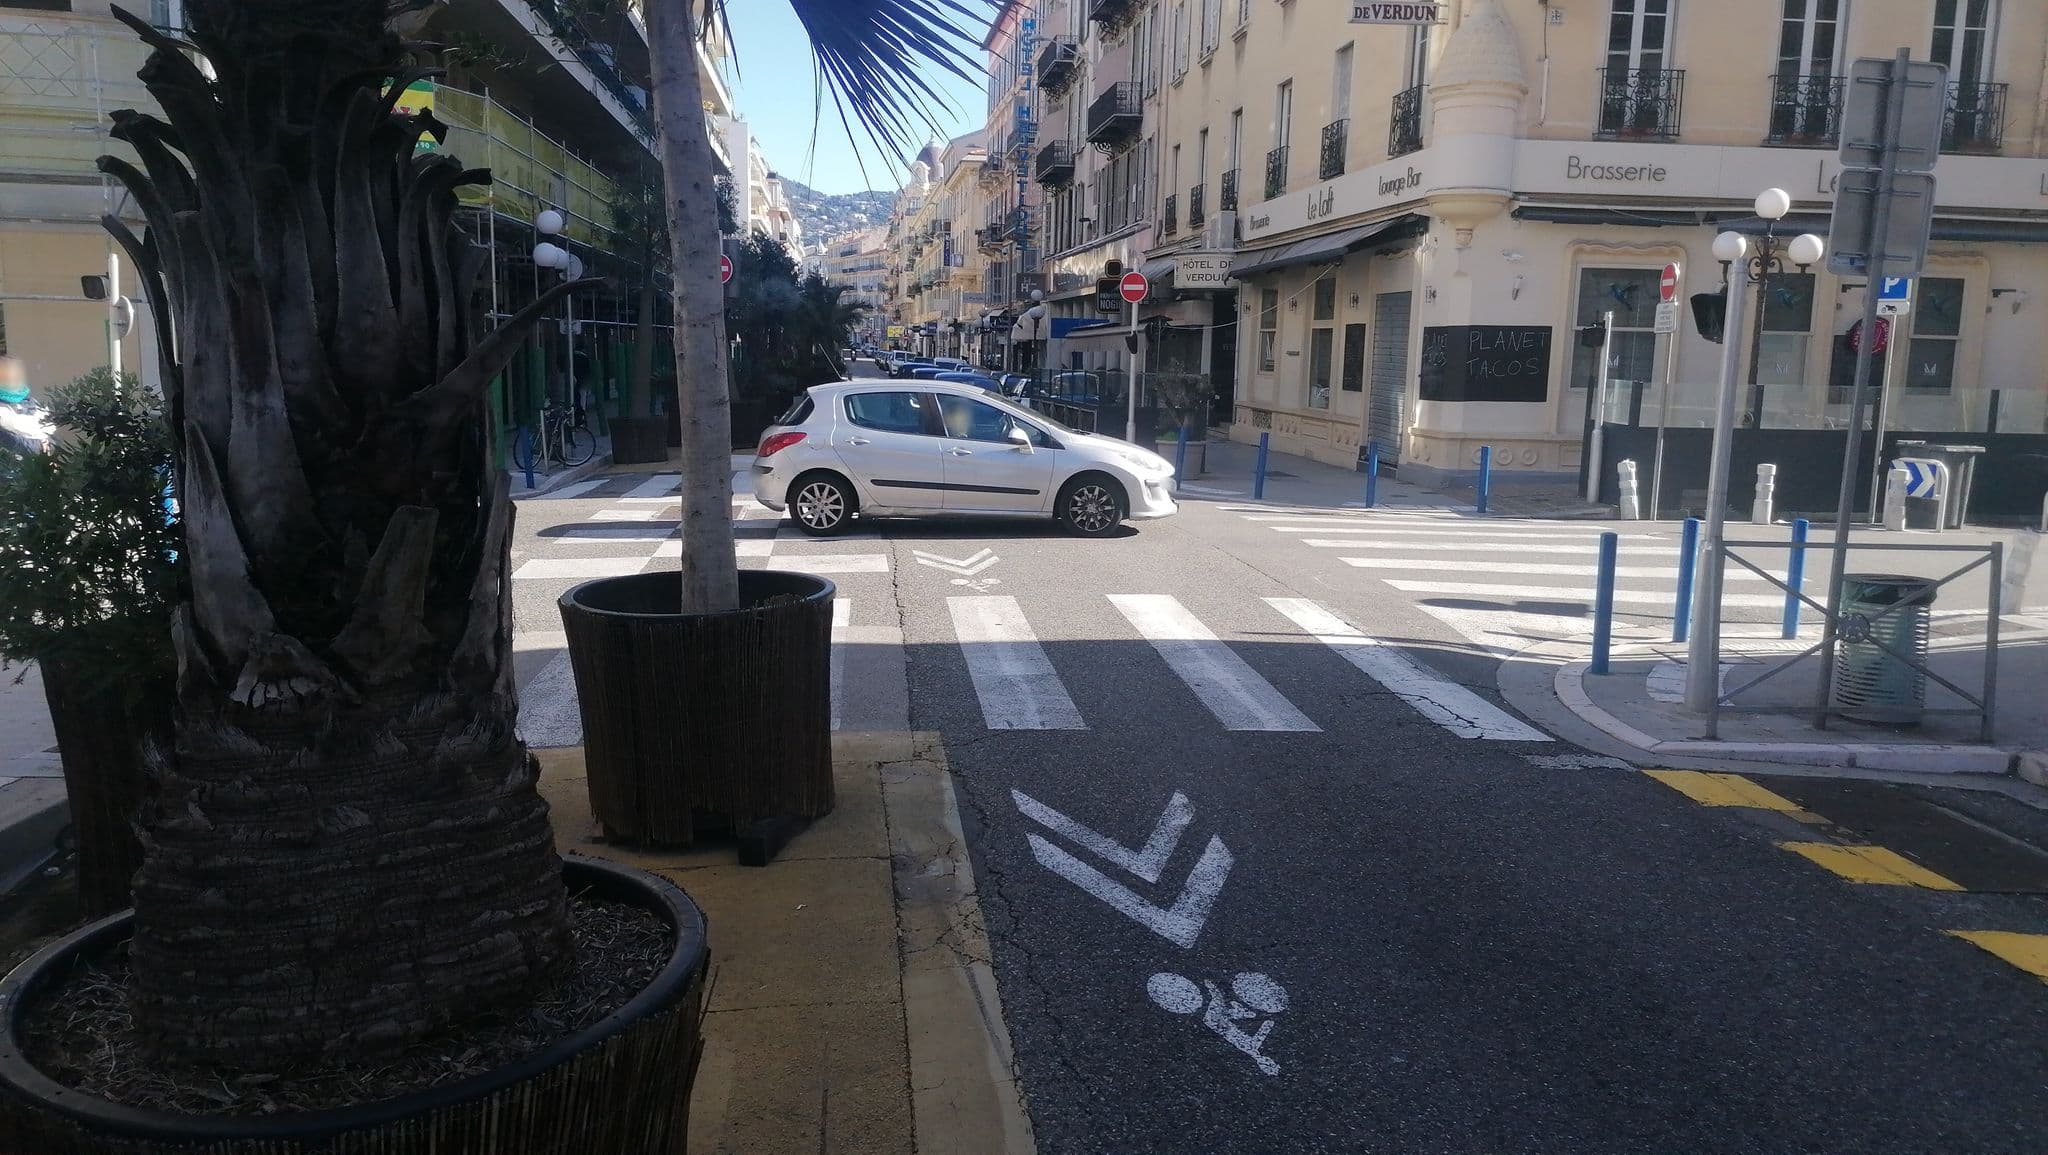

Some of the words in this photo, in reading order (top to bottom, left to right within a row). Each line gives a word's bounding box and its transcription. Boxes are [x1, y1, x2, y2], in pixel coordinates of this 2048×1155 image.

[1354, 7, 1370, 19] DE
[1371, 4, 1437, 21] VERDUN
[1567, 155, 1667, 182] Brasserie
[1307, 193, 1316, 220] Le
[1318, 186, 1335, 217] Loft
[1378, 176, 1405, 197] Lounge
[1406, 166, 1423, 188] Bar
[1182, 258, 1214, 269] HÔTEL
[1469, 330, 1551, 353] PLANET
[1465, 357, 1540, 379] TACOS
